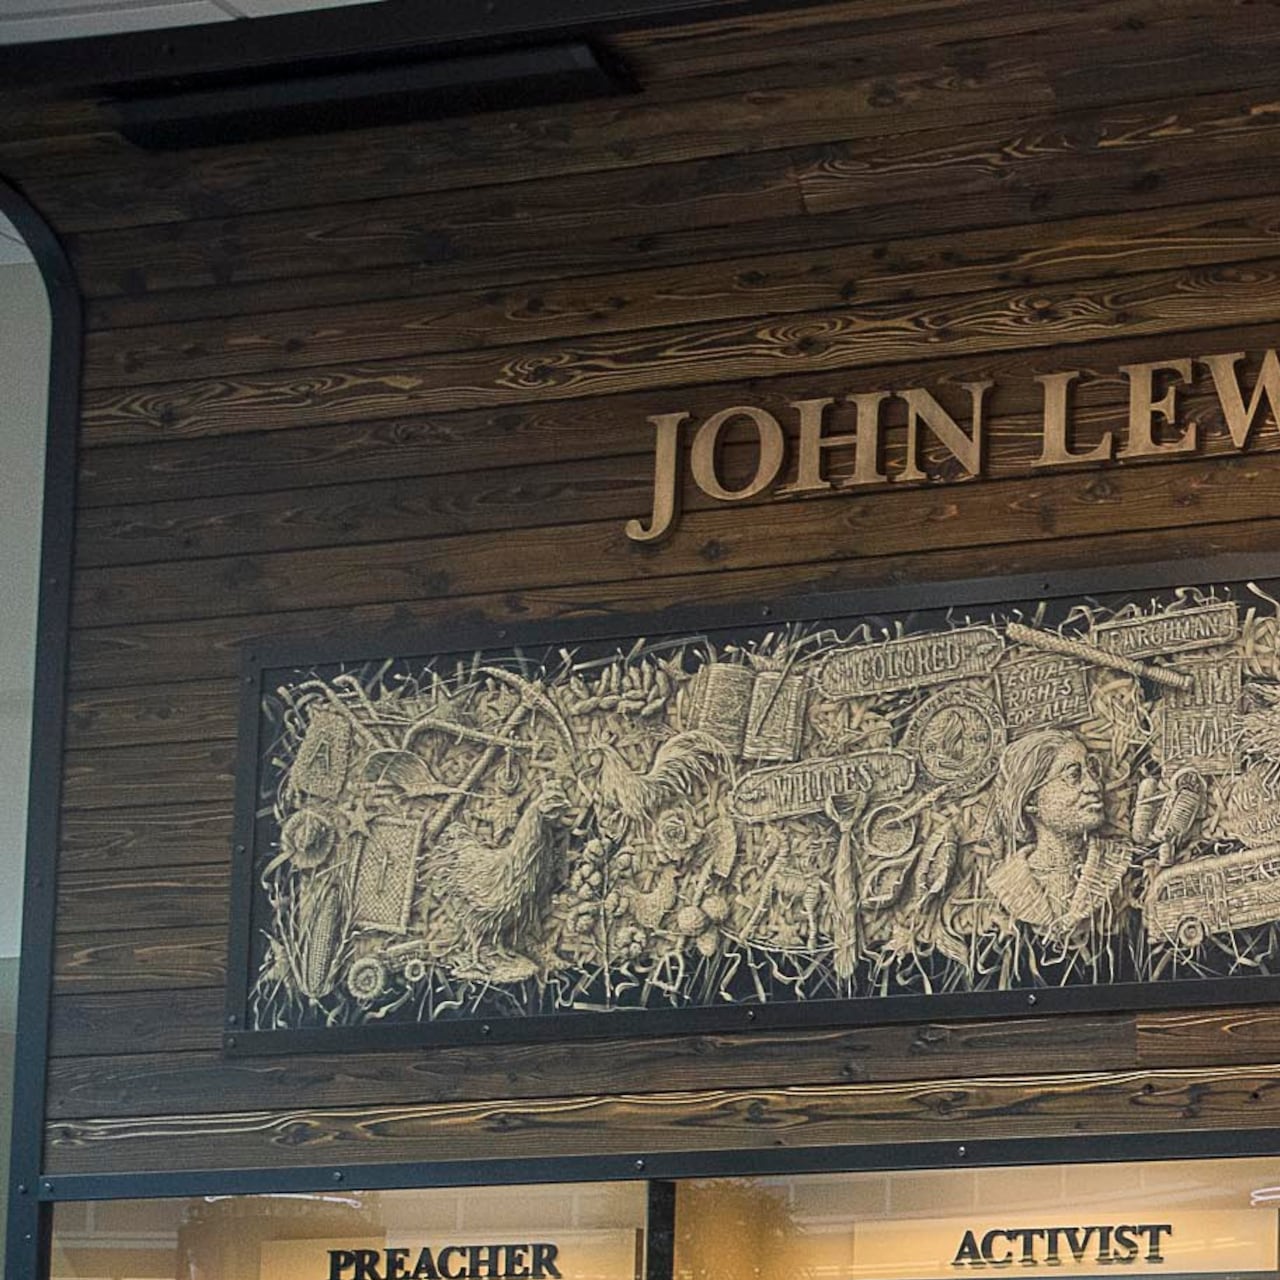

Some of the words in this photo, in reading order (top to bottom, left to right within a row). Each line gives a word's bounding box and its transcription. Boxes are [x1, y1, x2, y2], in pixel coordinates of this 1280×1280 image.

[625, 381, 994, 543] JOHN
[1111, 615, 1219, 650] PARCHMAN
[859, 640, 961, 686] COLORED
[1008, 660, 1067, 686] EQUAL
[1006, 679, 1072, 707] RIGHTS
[772, 761, 874, 803] WHITES
[951, 1224, 1171, 1266] ACTIVIST
